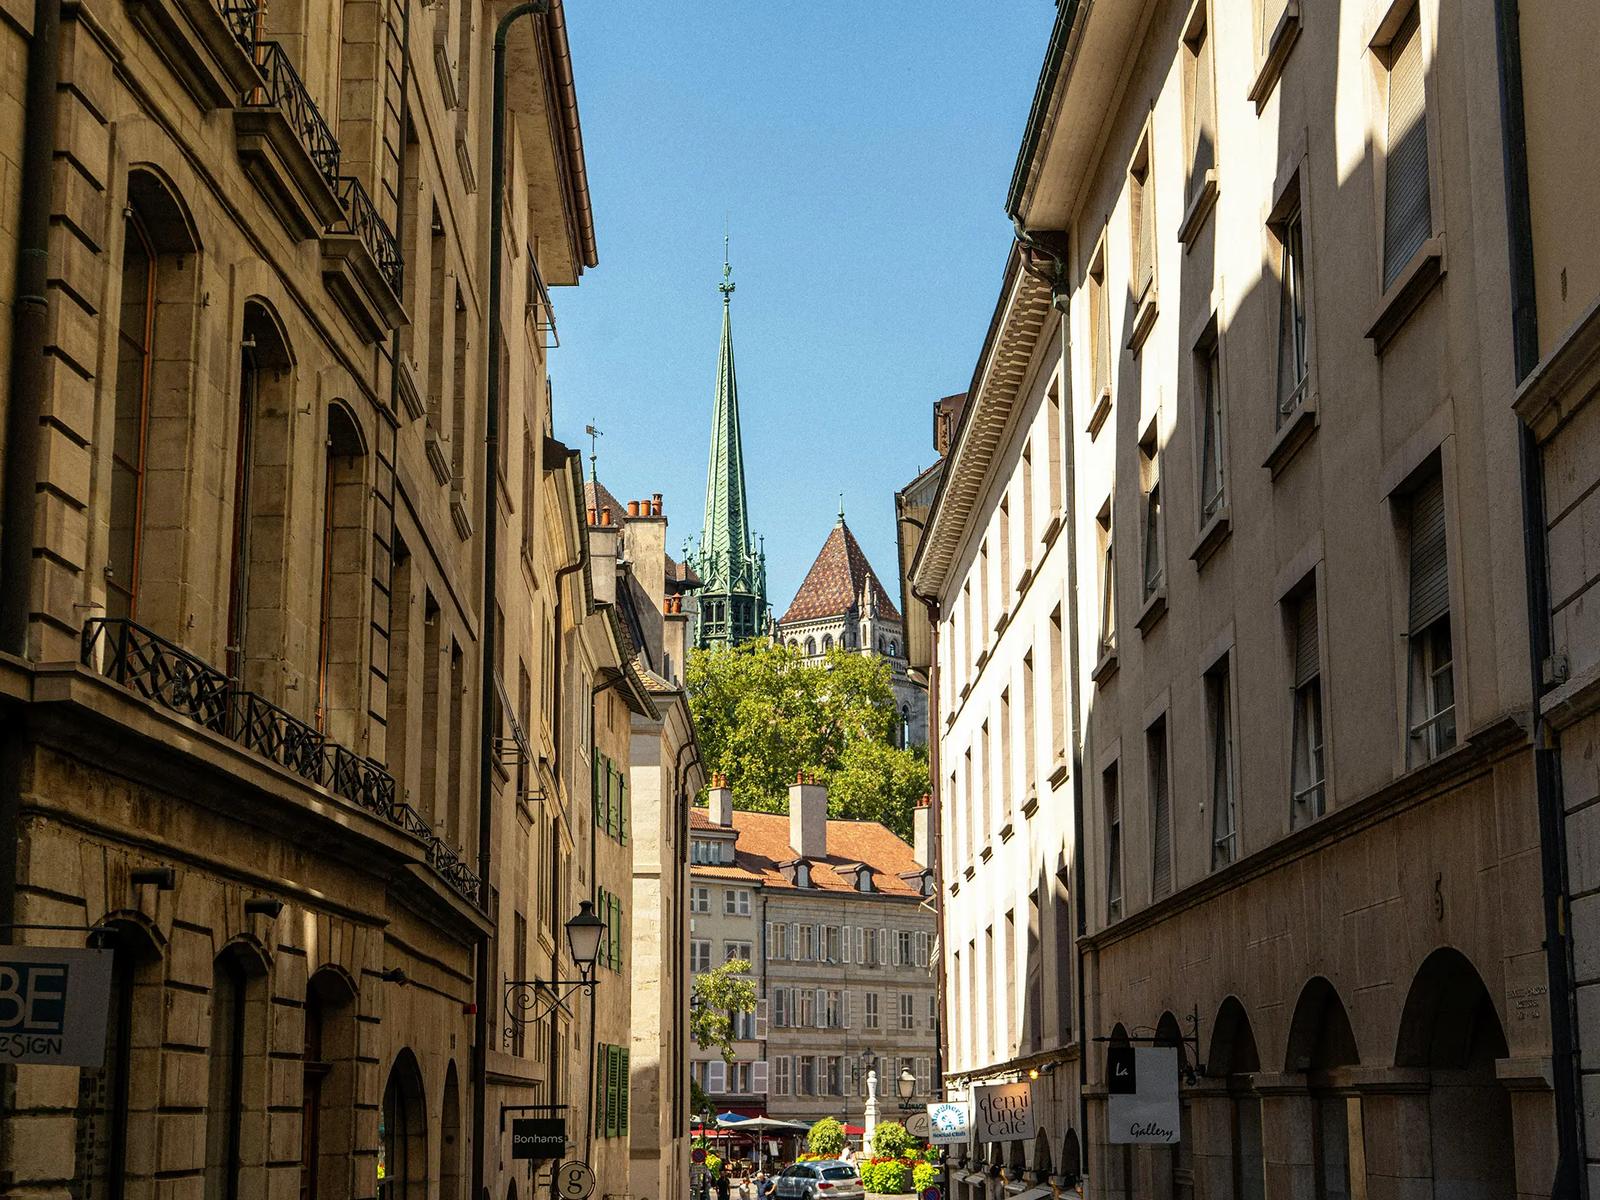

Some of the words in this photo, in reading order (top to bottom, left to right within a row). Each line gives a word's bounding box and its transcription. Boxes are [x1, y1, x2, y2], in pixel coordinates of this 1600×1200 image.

[1116, 1062, 1128, 1076] La
[980, 1091, 1028, 1111] demi
[931, 1104, 964, 1127] Margherita
[984, 1106, 1025, 1125] lune
[513, 1134, 564, 1144] Bonhams
[932, 1130, 951, 1138] Social
[952, 1129, 966, 1137] Club
[1130, 1122, 1173, 1141] Gallery
[567, 1169, 585, 1194] g
